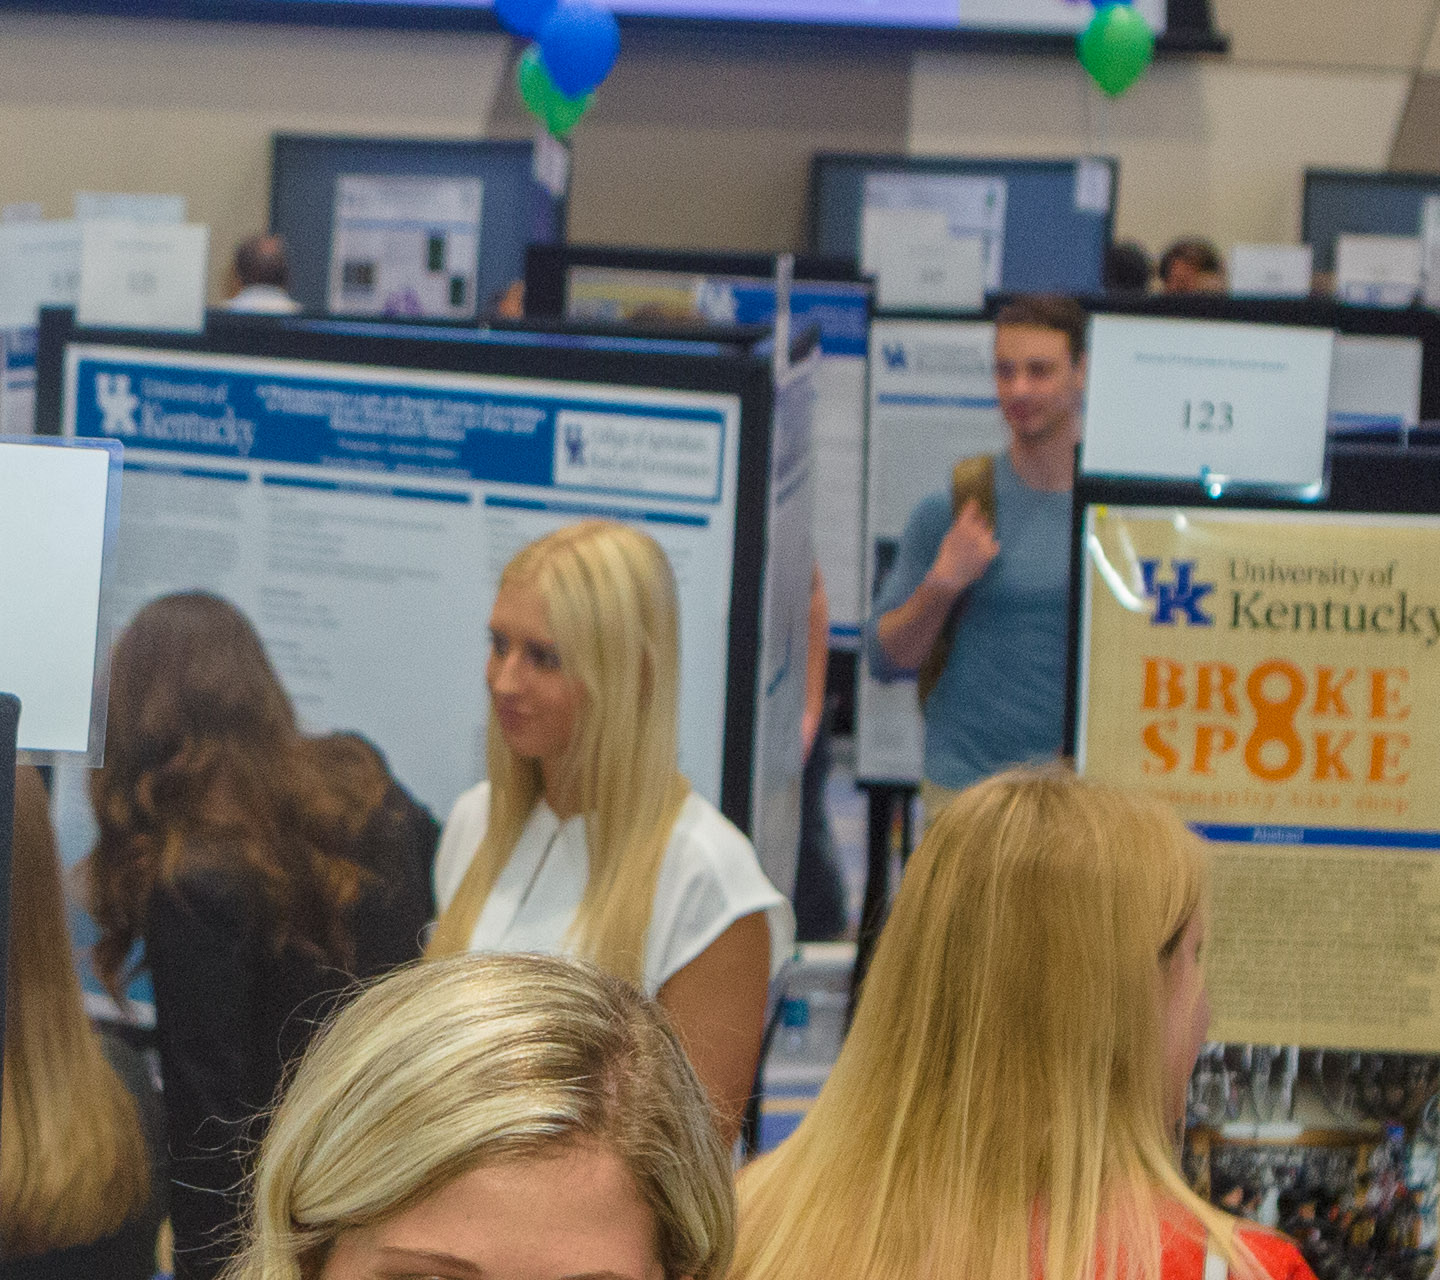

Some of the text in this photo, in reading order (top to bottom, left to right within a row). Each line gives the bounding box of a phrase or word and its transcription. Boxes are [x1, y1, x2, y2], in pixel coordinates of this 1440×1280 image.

[1183, 399, 1234, 433] 123
[1227, 558, 1398, 594] University of
[1140, 656, 1411, 721] BROKE
[1140, 719, 1411, 787] SPOKE
